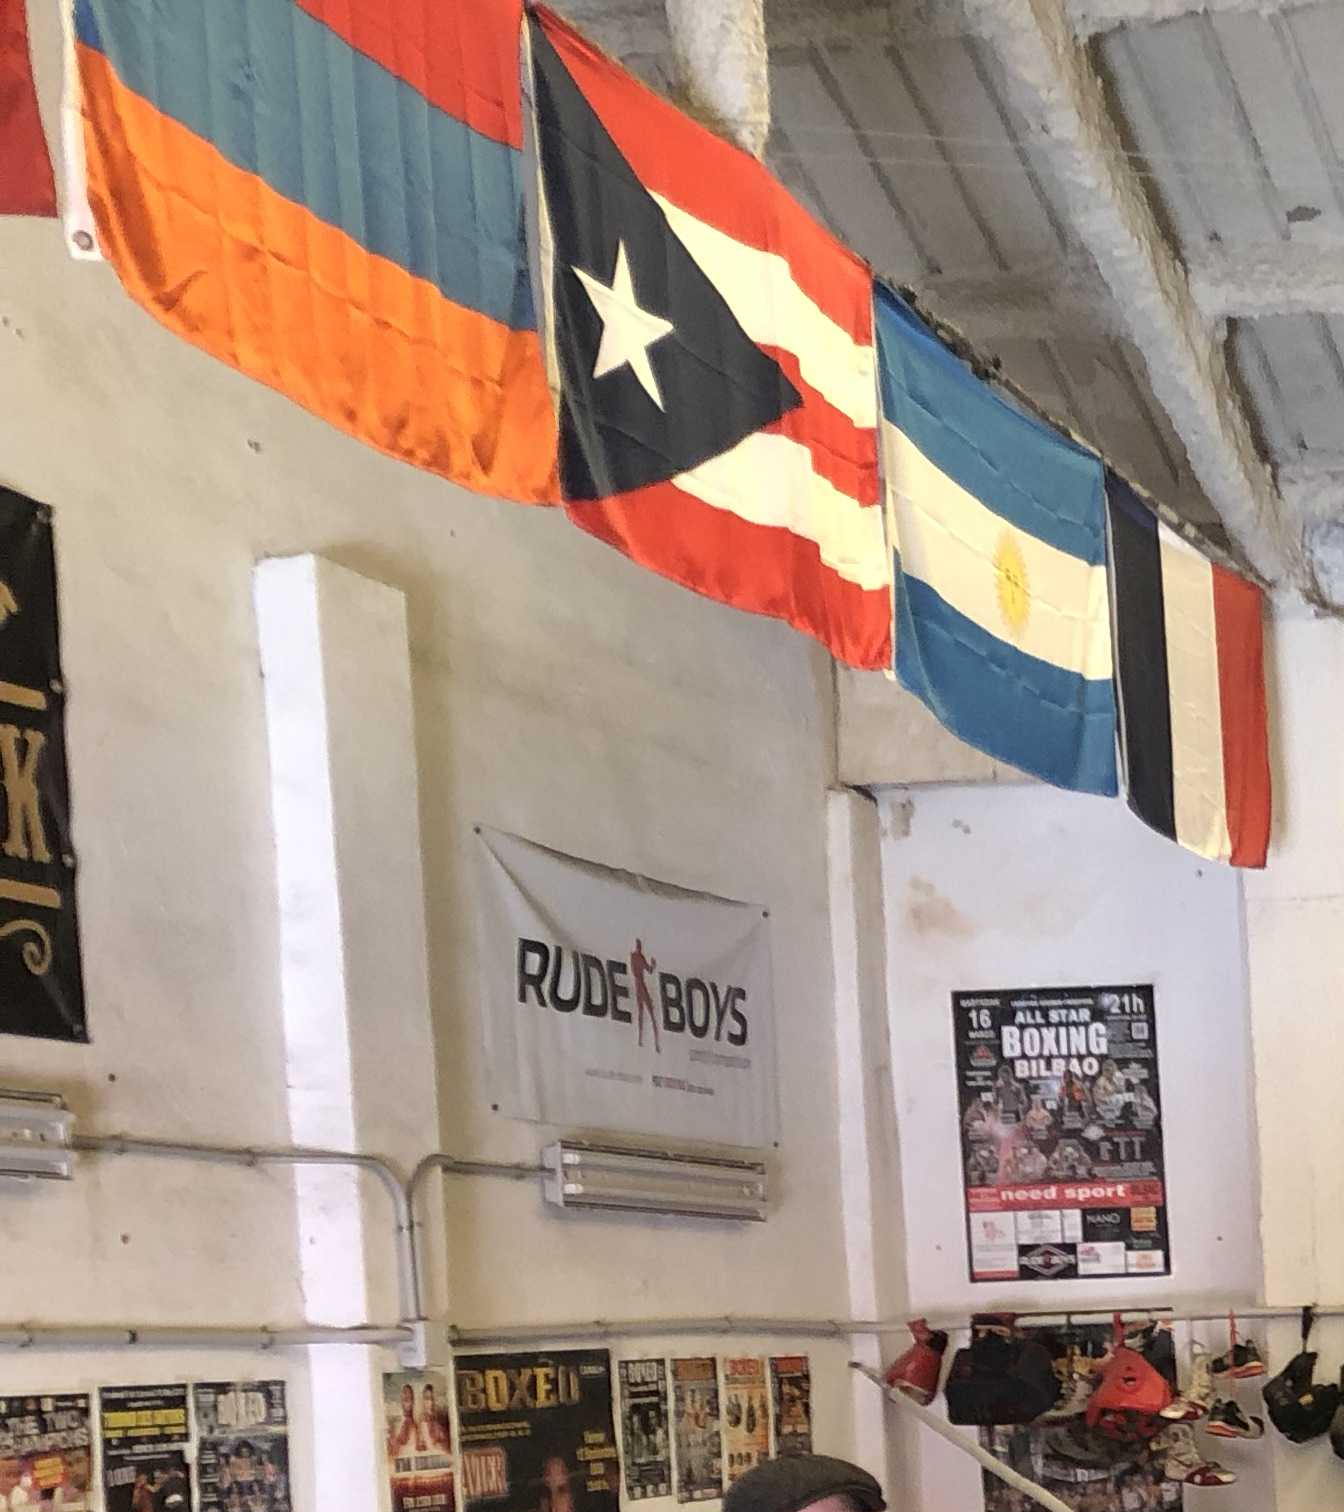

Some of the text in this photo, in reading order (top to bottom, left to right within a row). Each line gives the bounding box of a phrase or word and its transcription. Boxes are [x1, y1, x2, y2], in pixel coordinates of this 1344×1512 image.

[517, 937, 748, 1046] RUDE BOYS
[1109, 994, 1145, 1014] 21h
[968, 1009, 993, 1029] 16
[1014, 1008, 1091, 1025] ALL STAR
[1001, 1022, 1108, 1058] BOXING
[1014, 1057, 1100, 1079] BILBAO
[1001, 1182, 1126, 1201] need sport
[455, 1364, 580, 1413] BOXEO
